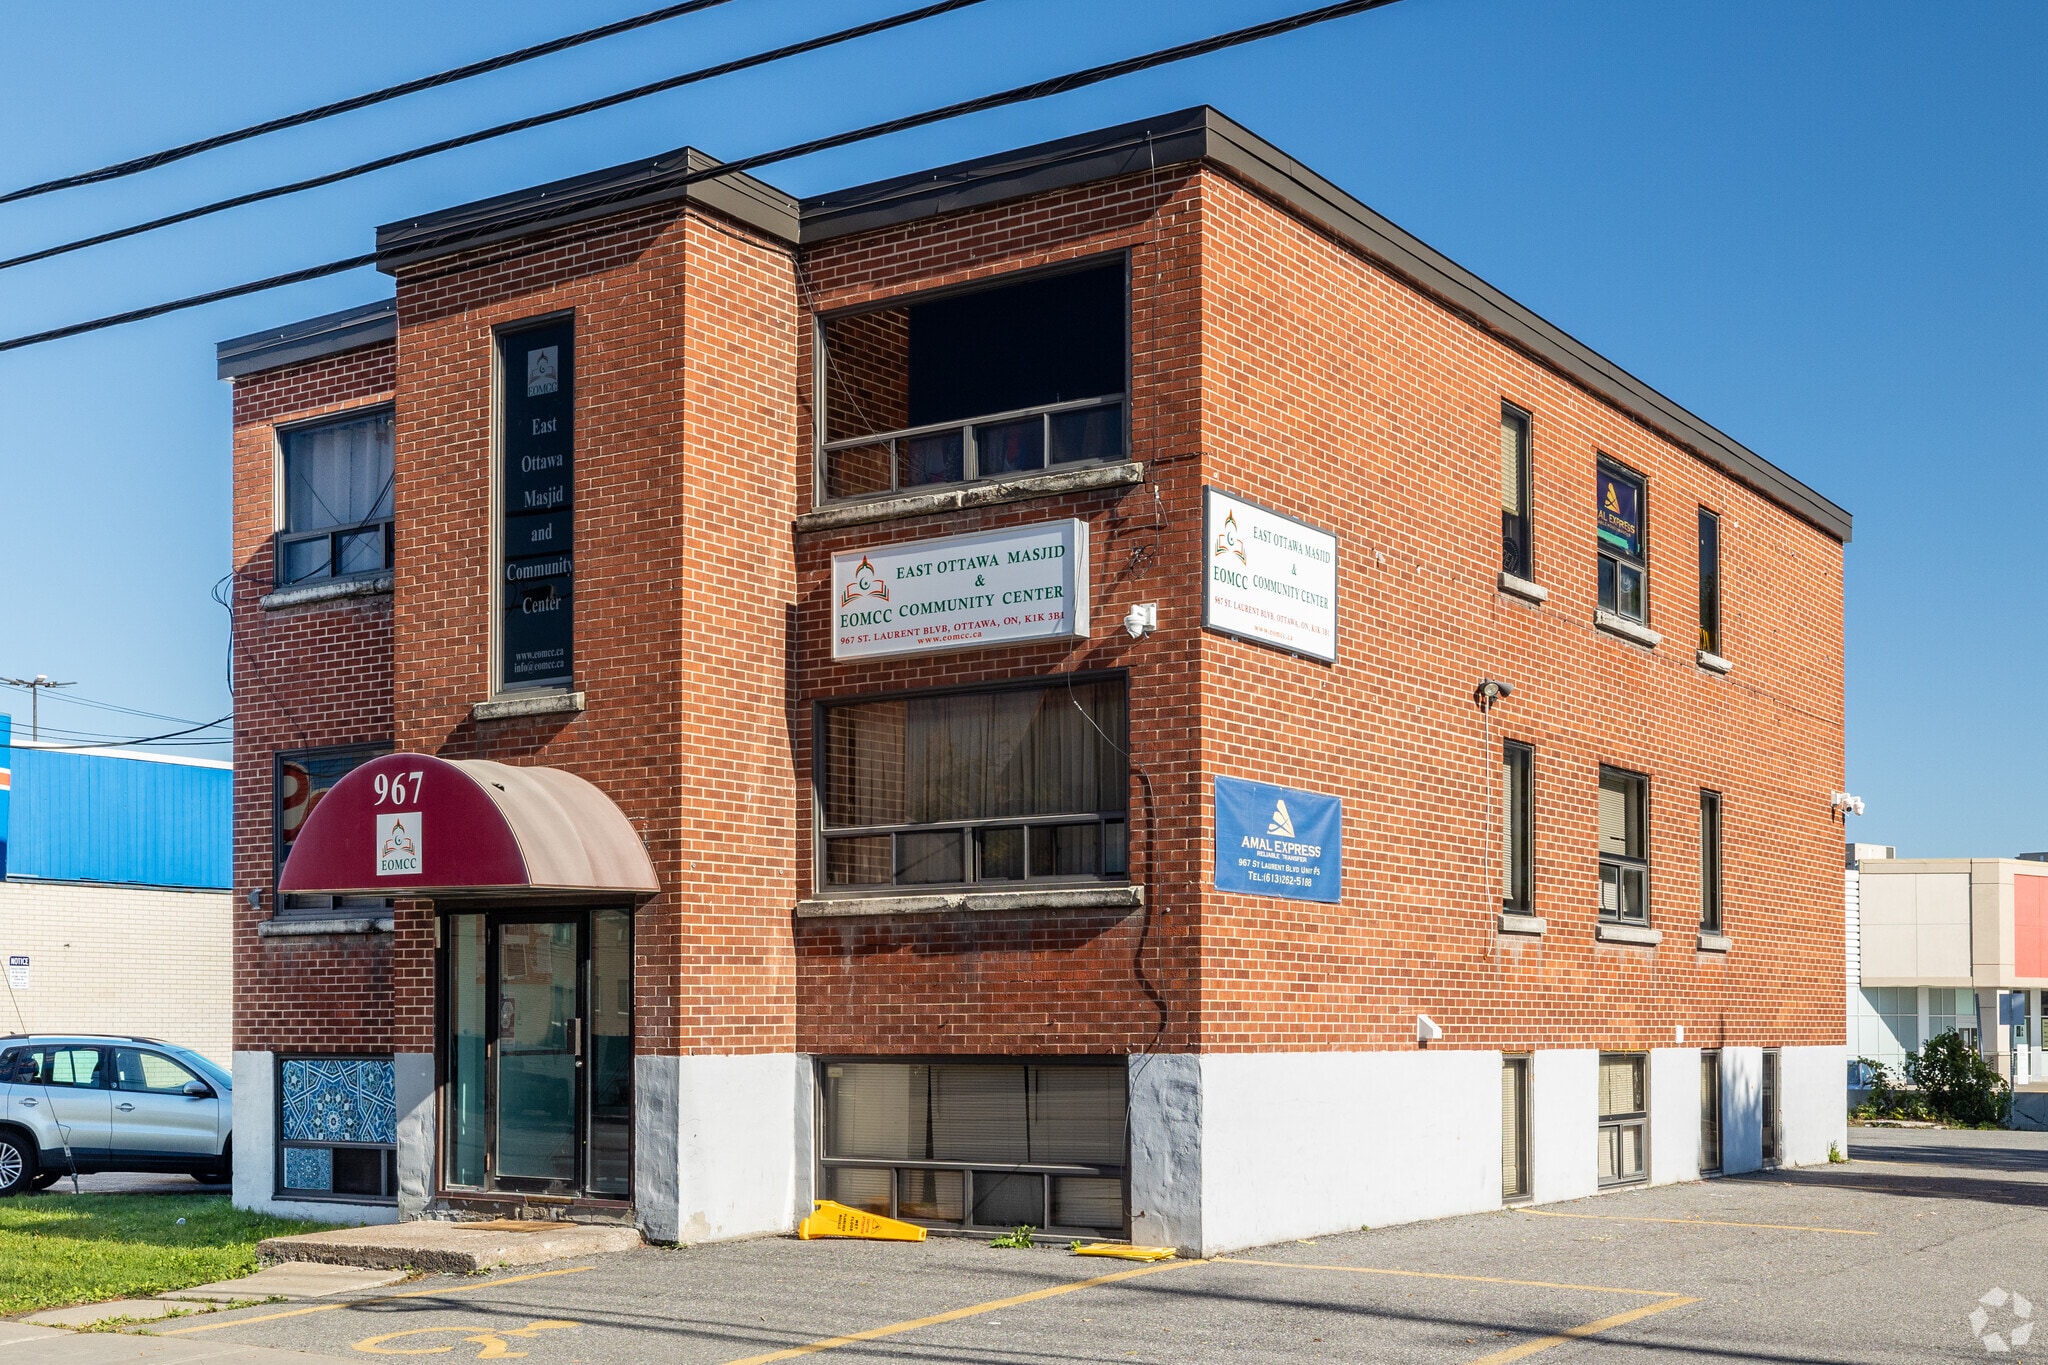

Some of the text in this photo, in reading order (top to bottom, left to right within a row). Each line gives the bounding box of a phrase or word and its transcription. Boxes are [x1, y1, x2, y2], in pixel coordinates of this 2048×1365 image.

[528, 382, 558, 396] EOMCC
[532, 417, 557, 436] East
[522, 454, 563, 472] Ottawa
[524, 485, 563, 508] Masjid
[531, 523, 552, 542] and
[1609, 514, 1635, 534] EXPRESS
[1254, 526, 1330, 564] EAST OTTAWA MASJID
[507, 557, 572, 581] Community
[896, 545, 1065, 579] EAST OTTAWA MASJID
[1292, 564, 1297, 576] &
[975, 575, 985, 586] &
[1214, 566, 1329, 609] EOMCC COMMUNITY CENTER
[523, 596, 561, 614] Center
[841, 586, 1064, 628] EOMCC COMMUNITY CENTER
[1234, 601, 1259, 616] LAURENT
[858, 635, 870, 643] ST.
[874, 628, 920, 640] LAURENT
[924, 625, 950, 634] BLVB,
[954, 620, 1000, 631] OTTAWA,
[1004, 617, 1021, 625] ON,
[1025, 614, 1045, 623] K1K
[1048, 612, 1064, 620] 3B1
[1255, 626, 1294, 641] www.eomcc.ca
[918, 632, 982, 644] www.eomcc.ca
[516, 648, 564, 660] www.eomcc.ca
[514, 660, 564, 674] info@eomcc.ca
[374, 771, 423, 805] 967
[1241, 836, 1321, 858] AMAL EXPRESS
[382, 858, 416, 870] EOMCC
[1257, 851, 1307, 862] RELIABLE TRANSFER
[1313, 867, 1320, 875] #5
